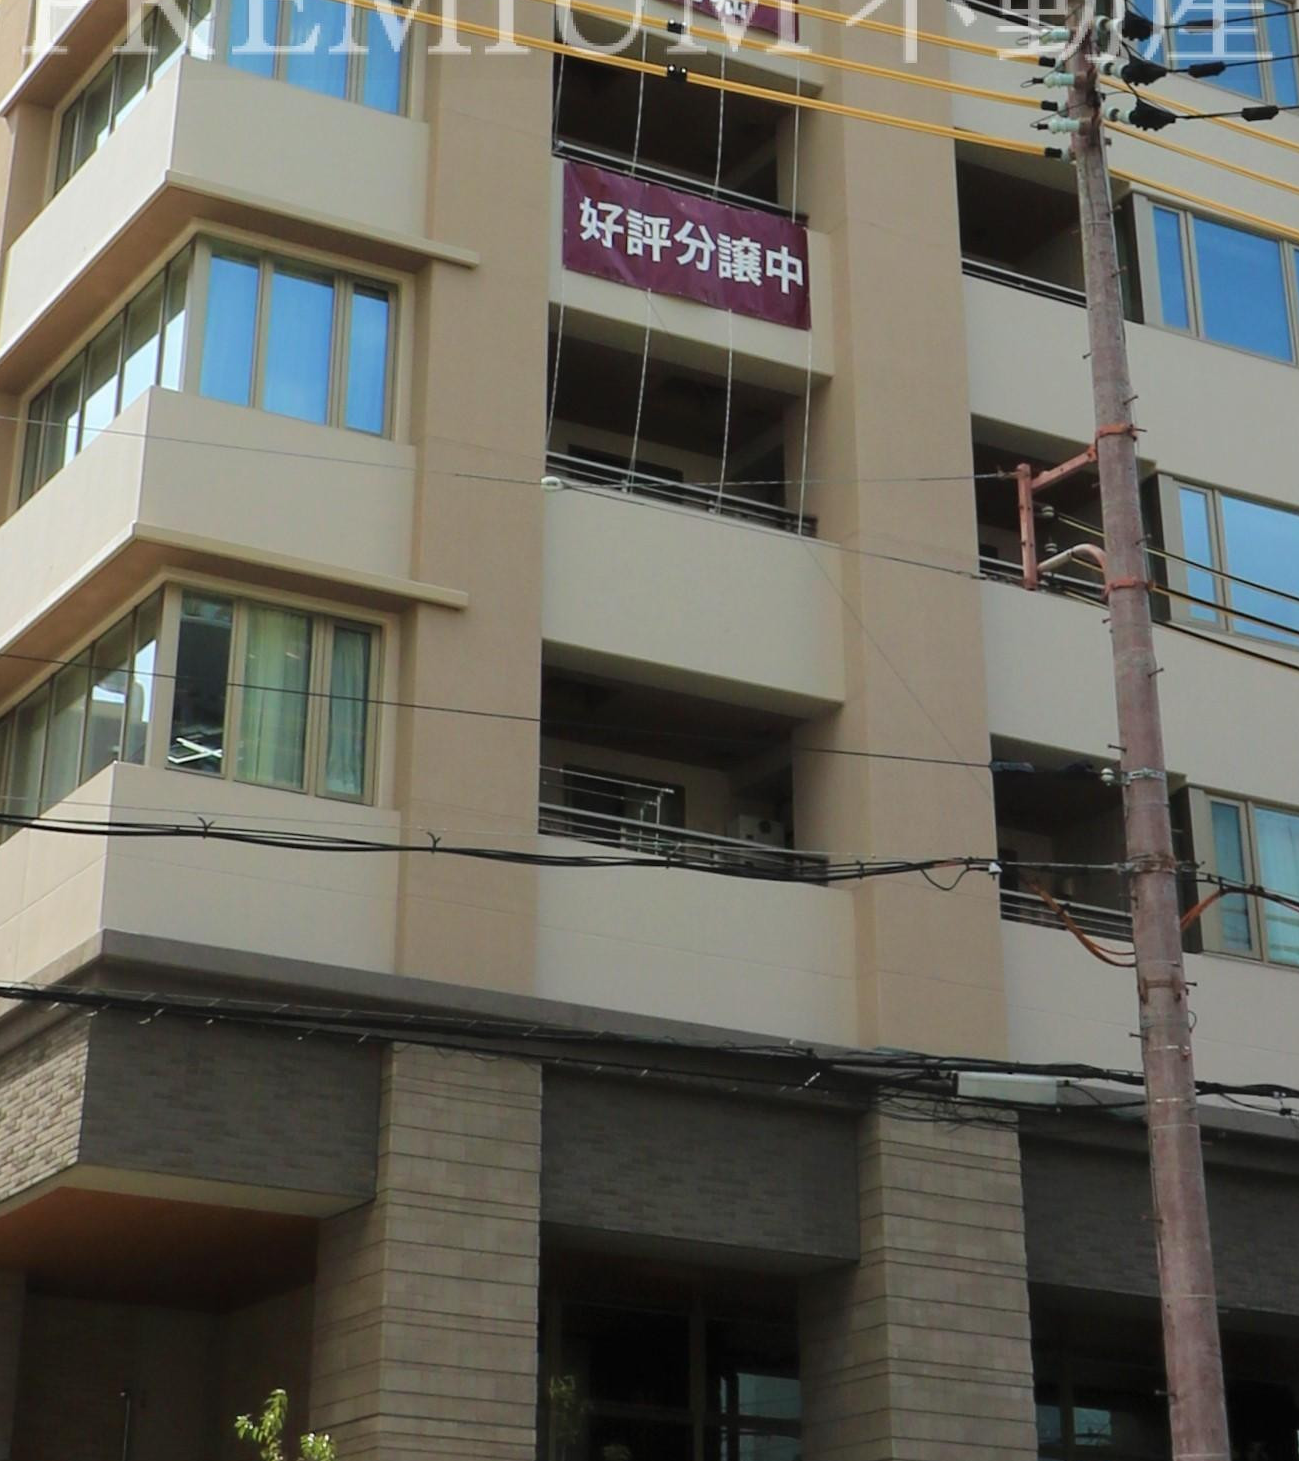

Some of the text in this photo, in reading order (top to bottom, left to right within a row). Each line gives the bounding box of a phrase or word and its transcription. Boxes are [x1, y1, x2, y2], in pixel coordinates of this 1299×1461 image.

[578, 195, 804, 294] 好評分譲中
